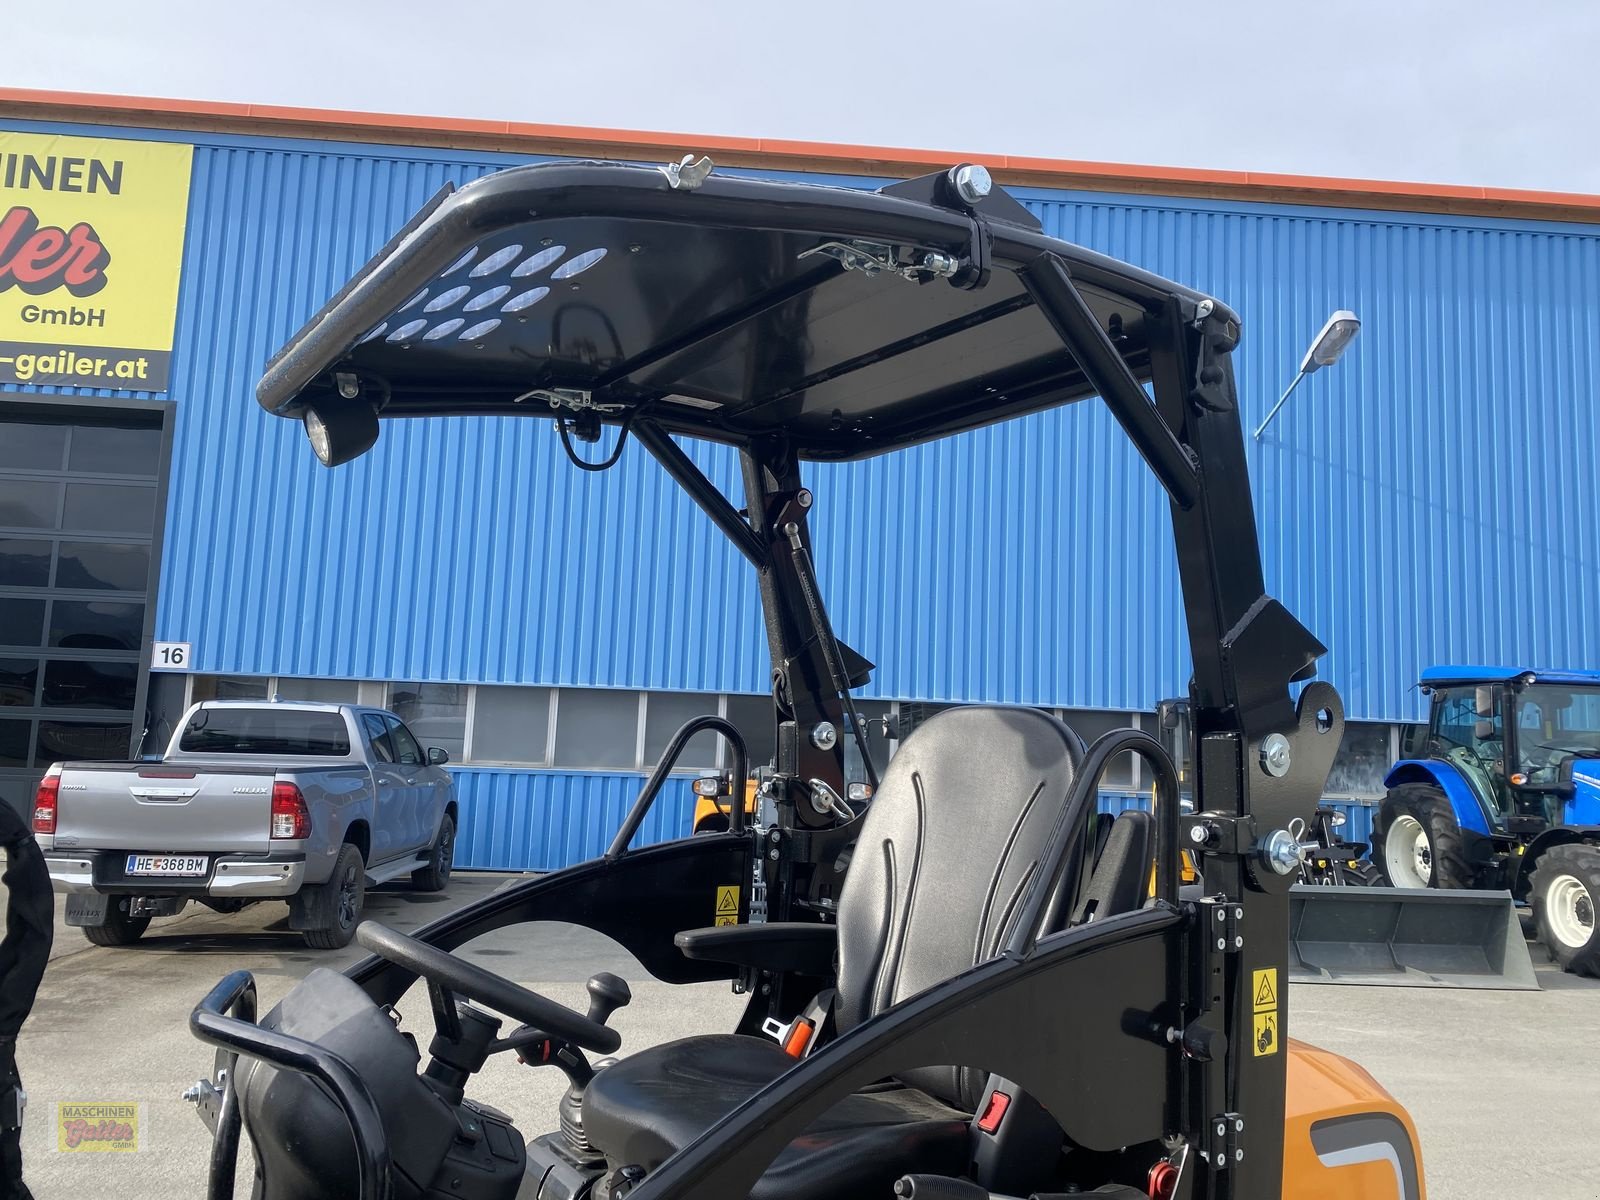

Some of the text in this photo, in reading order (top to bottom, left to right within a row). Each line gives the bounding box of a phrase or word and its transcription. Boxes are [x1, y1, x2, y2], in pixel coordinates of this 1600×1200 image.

[0, 153, 123, 195] INEN
[21, 305, 105, 327] GmbH
[161, 647, 184, 664] 16
[232, 786, 268, 795] HILUX
[136, 857, 203, 871] HE 368 BM
